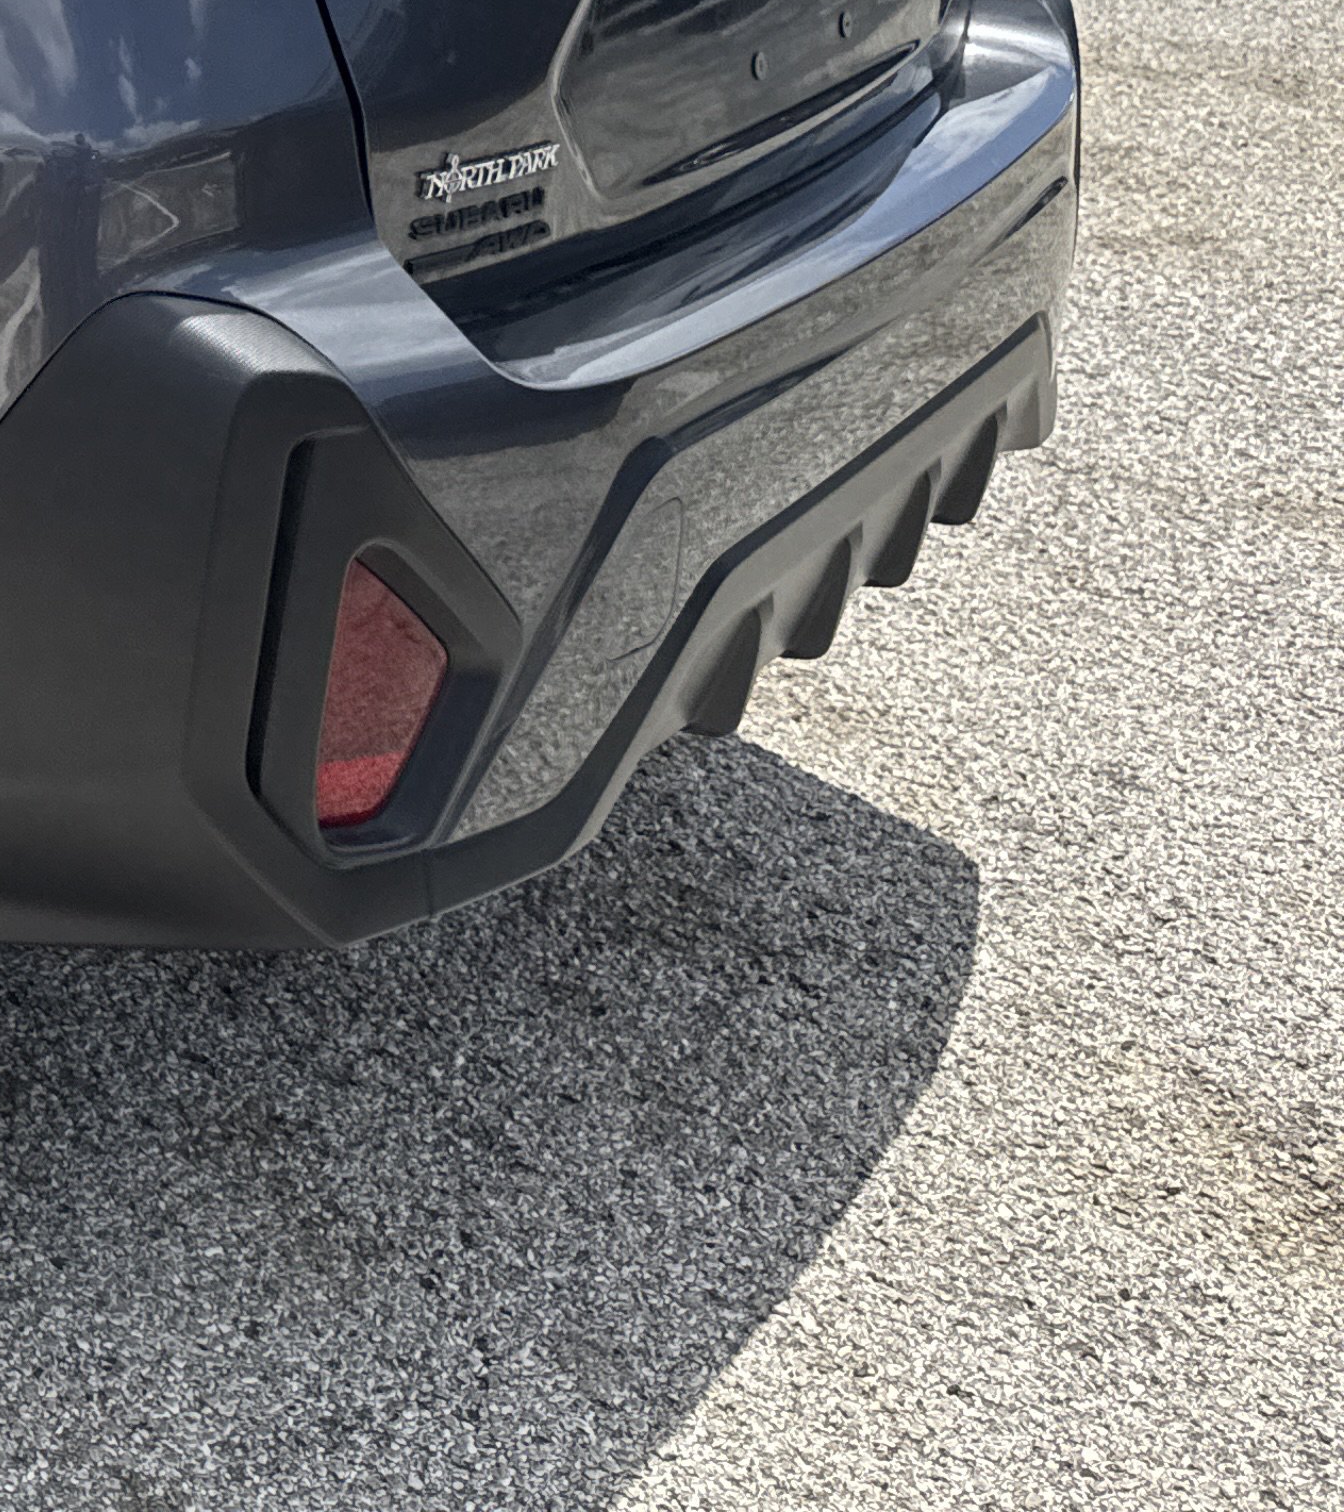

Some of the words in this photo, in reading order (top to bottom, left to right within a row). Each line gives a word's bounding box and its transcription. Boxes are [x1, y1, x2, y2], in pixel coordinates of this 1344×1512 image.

[423, 153, 508, 203] NORTH
[508, 144, 561, 179] PARK
[408, 186, 545, 240] SUBARU
